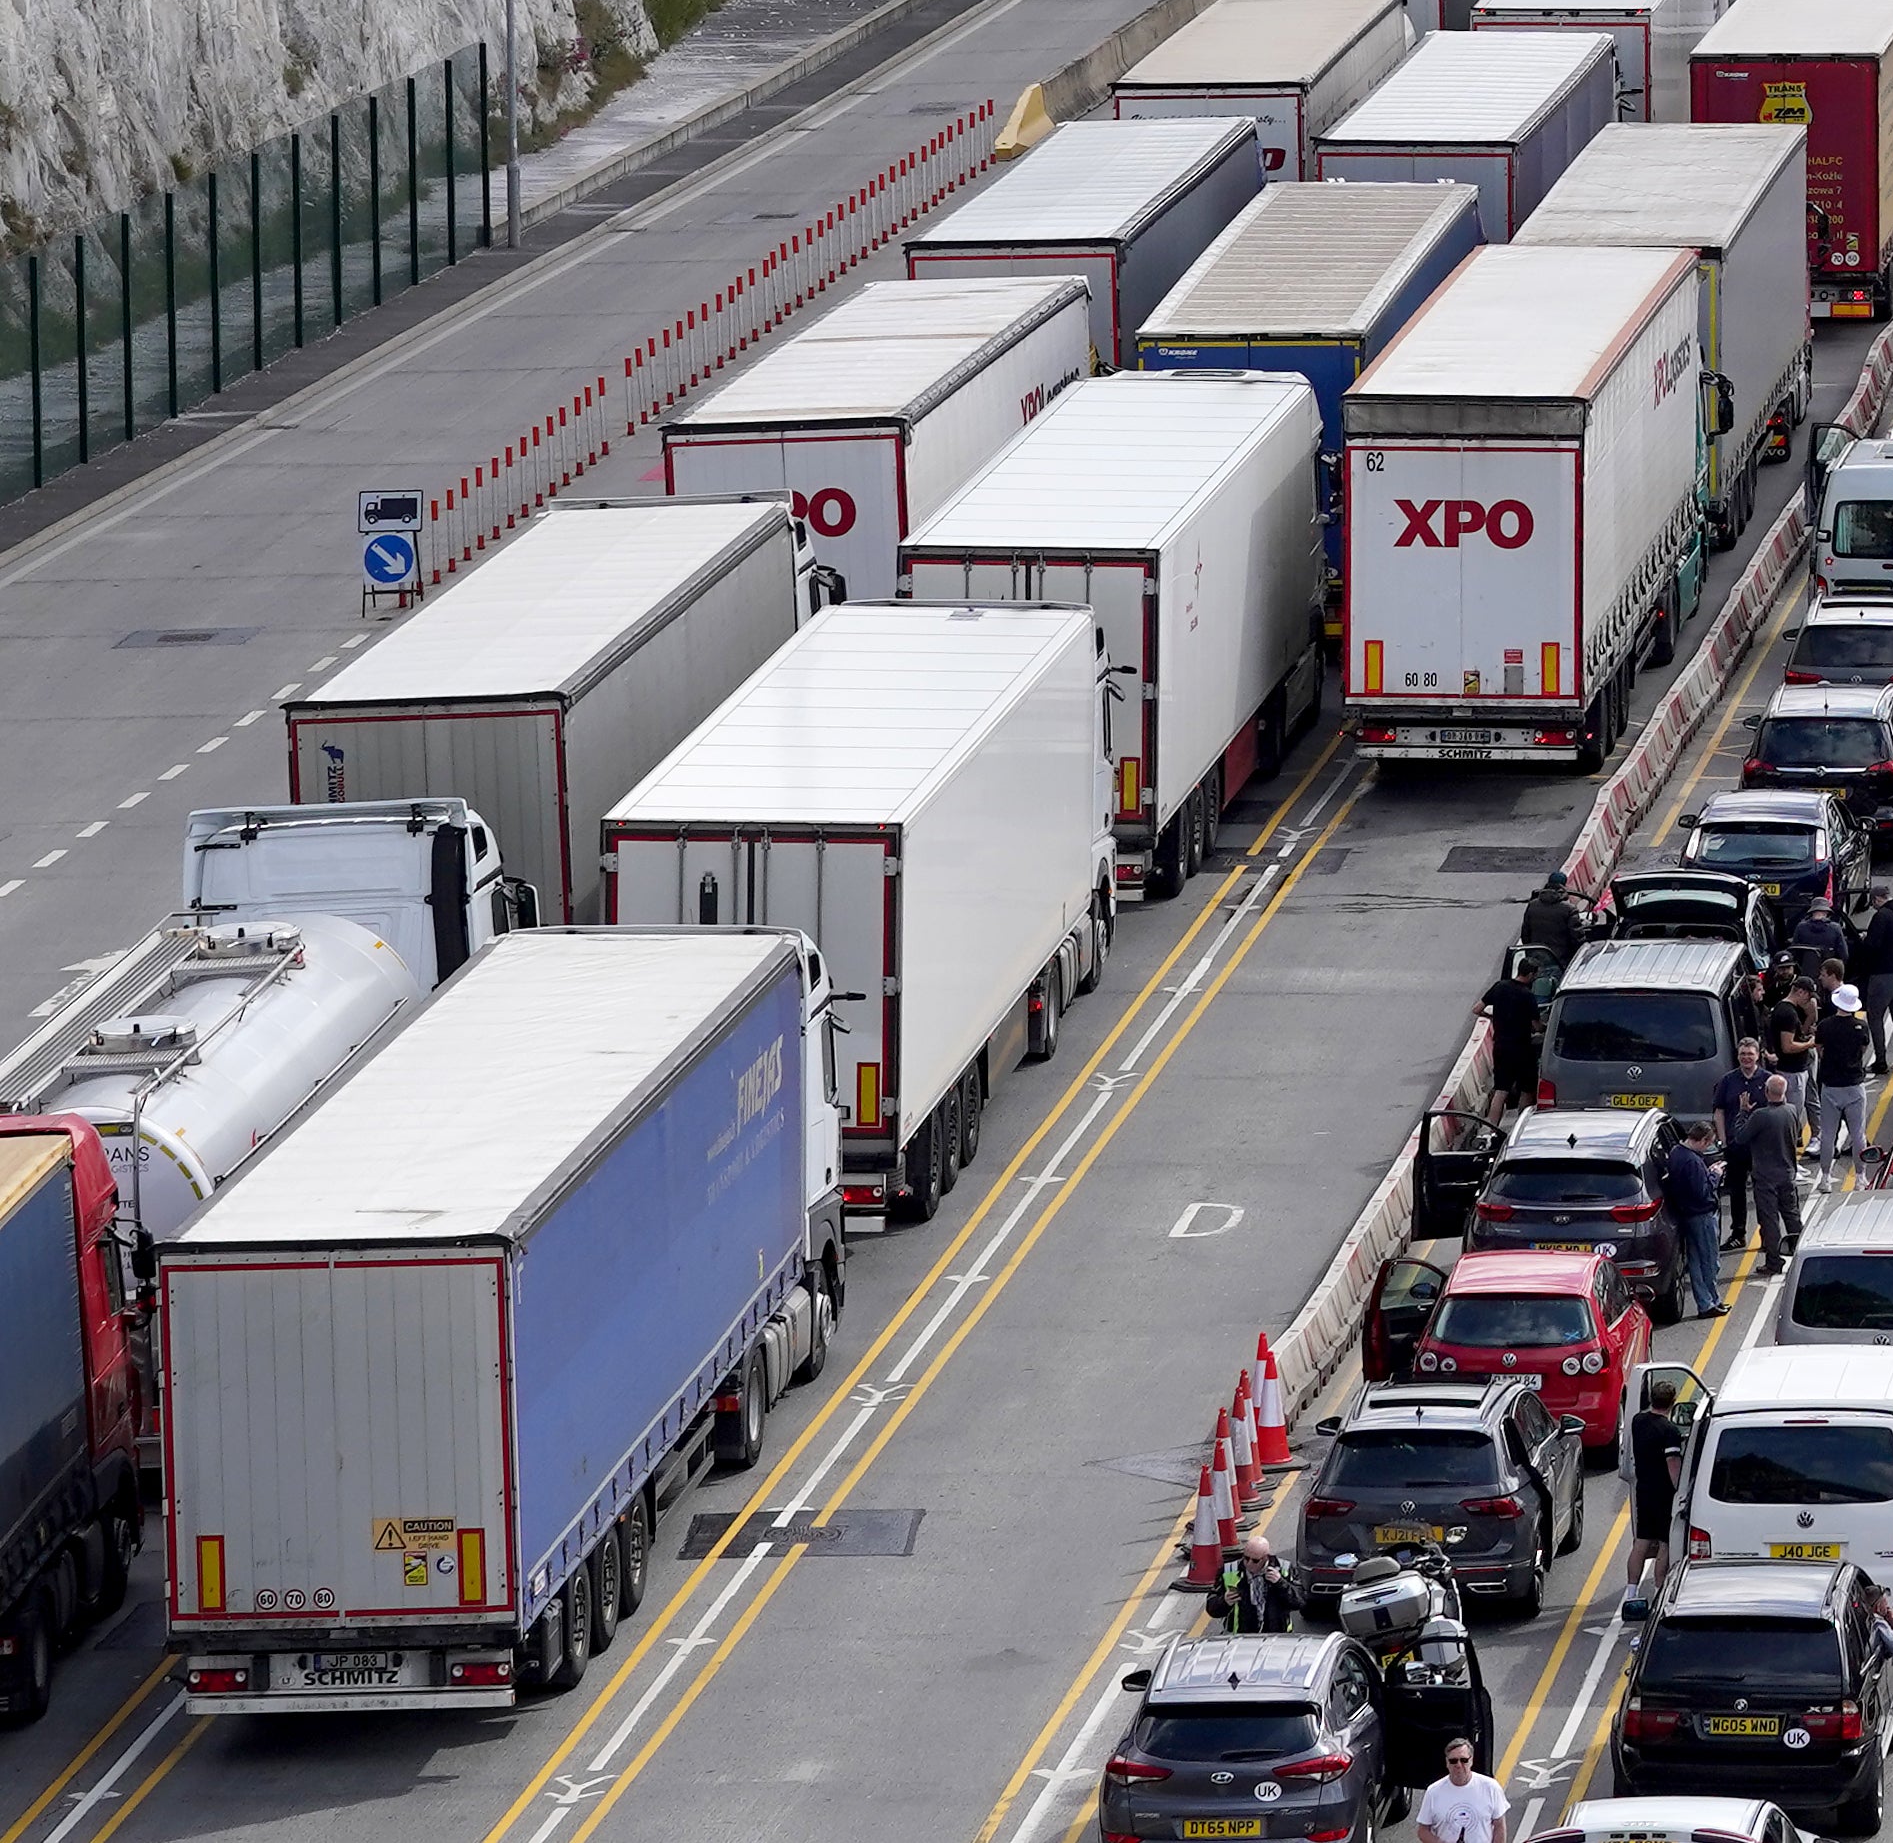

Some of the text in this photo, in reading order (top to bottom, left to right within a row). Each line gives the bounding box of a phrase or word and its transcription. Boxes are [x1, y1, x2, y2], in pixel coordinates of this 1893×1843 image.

[1767, 84, 1802, 93] TRANS
[1366, 451, 1385, 473] 62
[1393, 499, 1535, 550] XPO
[1404, 672, 1438, 687] 60 80
[1437, 748, 1493, 758] SCHMITZ
[1612, 1096, 1659, 1108] GL15 OEZ
[1168, 1202, 1245, 1238] D
[1600, 1245, 1612, 1253] UK
[404, 1520, 453, 1532] CAUTION
[407, 1534, 449, 1543] LEFT HAND
[417, 1542, 441, 1550] DRIVE
[1779, 1545, 1832, 1558] J40 JGE
[259, 1592, 331, 1604] 60 70 80
[329, 1654, 349, 1667] JP
[303, 1668, 399, 1686] SCHMITZ
[1712, 1718, 1806, 1745] WG05 WND UK
[1257, 1785, 1278, 1798] UK
[1189, 1820, 1255, 1835] DT65 NPP
